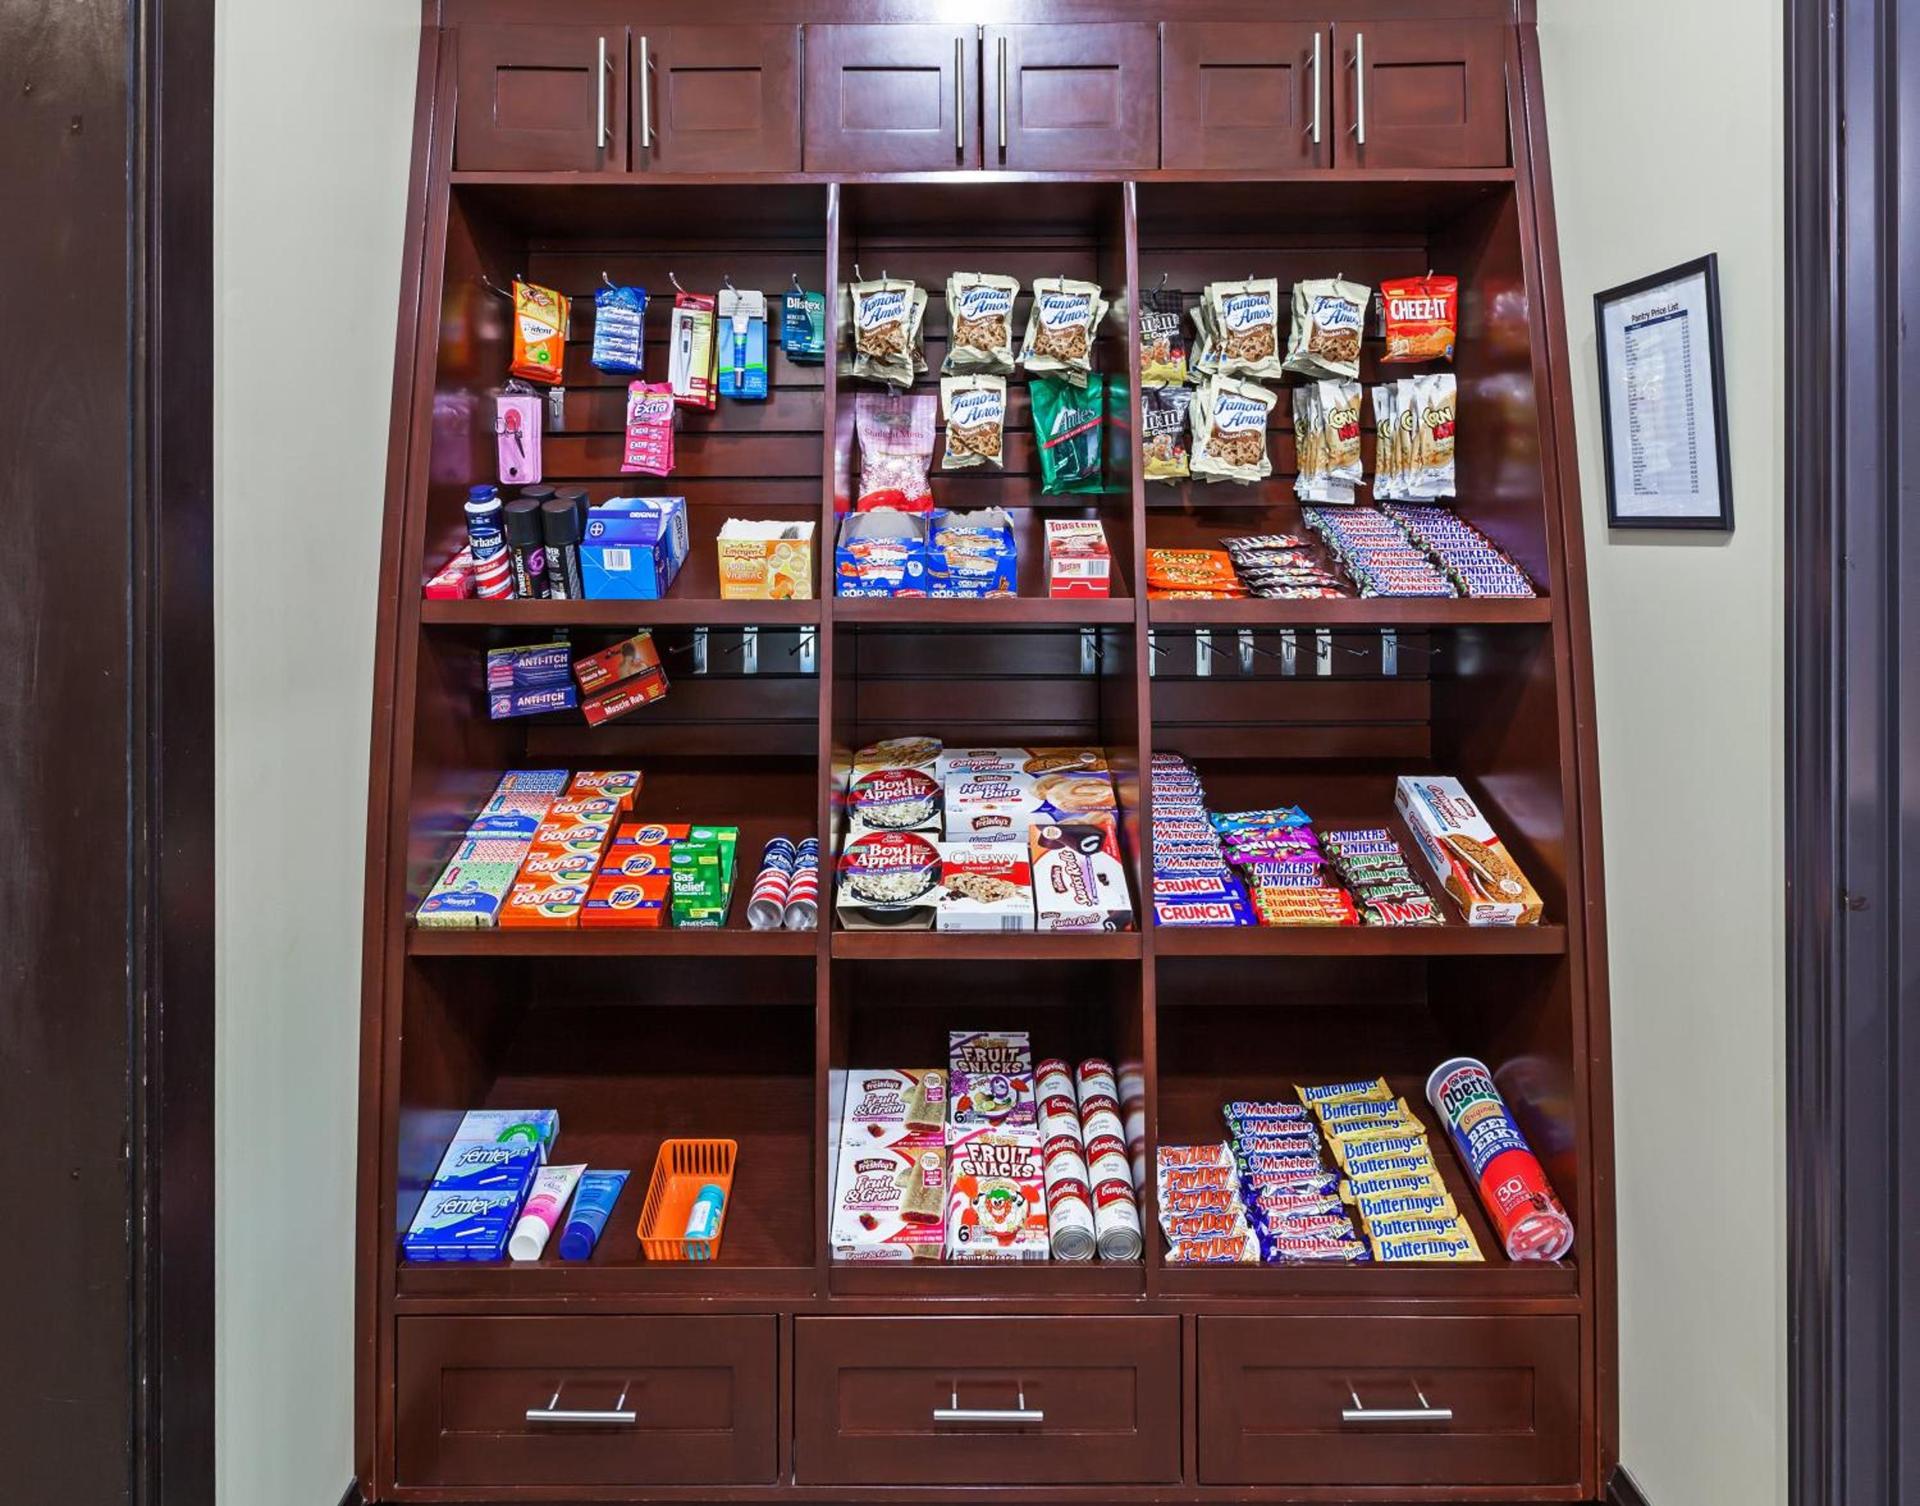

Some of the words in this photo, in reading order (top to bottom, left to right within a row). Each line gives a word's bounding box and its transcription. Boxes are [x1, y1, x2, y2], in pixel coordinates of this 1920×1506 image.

[786, 297, 822, 311] Blistex
[959, 290, 1010, 307] Famous
[1041, 295, 1090, 311] Famous
[1225, 294, 1270, 317] Famous
[864, 304, 904, 327] Amos
[967, 299, 1010, 317] Amos
[1046, 307, 1091, 325] Amos
[1389, 298, 1448, 321] CHEEZ-IT
[1234, 309, 1270, 327] Amos
[950, 392, 1001, 413] Famous
[1213, 396, 1267, 416] Famous
[1222, 411, 1265, 428] Amos
[629, 511, 660, 519] ORIGINAL
[1049, 521, 1099, 533] Toastem
[1432, 541, 1488, 549] SNICKERS
[1442, 550, 1497, 558] SNICKERS
[1451, 558, 1505, 566] SNICKERS
[1460, 566, 1515, 575] SNICKERS
[1467, 575, 1525, 585] SNICKERS
[1471, 584, 1532, 594] SNICKERS
[518, 653, 568, 668] ANTI-ITCH
[517, 692, 565, 706] ANTI-ITCH
[603, 699, 631, 715] Muscle
[629, 693, 645, 704] Rub
[873, 777, 913, 791] Bowl
[959, 783, 1007, 795] Honey
[981, 789, 1021, 800] Buns
[637, 829, 665, 842] Tide
[1331, 831, 1386, 842] SNICKERS
[869, 843, 912, 856] Bowl
[1342, 843, 1397, 854] SNICKERS
[624, 858, 652, 872] Tide
[949, 850, 1019, 868] Chewy
[1256, 862, 1313, 874] SNICKERS
[673, 872, 694, 882] Gas
[1154, 877, 1222, 893] CRUNCH
[1262, 875, 1321, 887] SNICKERS
[673, 880, 706, 892] Relief
[513, 890, 575, 906] bounce
[611, 889, 640, 905] Tide
[1161, 905, 1230, 920] CRUNCH
[961, 1047, 1020, 1062] FRUIT
[957, 1061, 1024, 1074] SNACKS
[863, 1092, 899, 1110] Fruit
[1443, 1077, 1495, 1115] Oberto
[868, 1102, 906, 1115] Grain
[1245, 1104, 1301, 1115] Musketeers
[1321, 1099, 1398, 1120] Butterfinger
[1464, 1103, 1496, 1126] Original
[954, 1111, 966, 1124] 6
[1468, 1118, 1509, 1142] BEEF
[968, 1144, 1031, 1163] FRUIT
[1342, 1138, 1422, 1158] Butterfinger
[1471, 1127, 1520, 1164] JERKY
[455, 1146, 515, 1167] femtex
[962, 1162, 1033, 1177] SNACKS
[1349, 1156, 1429, 1175] Butterfinger
[854, 1175, 894, 1194] Fruit
[1349, 1175, 1431, 1197] Butterfinger
[1496, 1178, 1523, 1204] 30
[860, 1188, 902, 1203] Grain
[1167, 1189, 1234, 1212] PayDay
[432, 1194, 492, 1217] femtex
[1359, 1197, 1446, 1218] Butterfinger
[1168, 1212, 1239, 1237] PayDay
[1371, 1218, 1457, 1238] Butterfinger
[957, 1226, 969, 1242] 6
[1177, 1234, 1249, 1260] PayDay
[1380, 1240, 1470, 1260] Butterfinger
